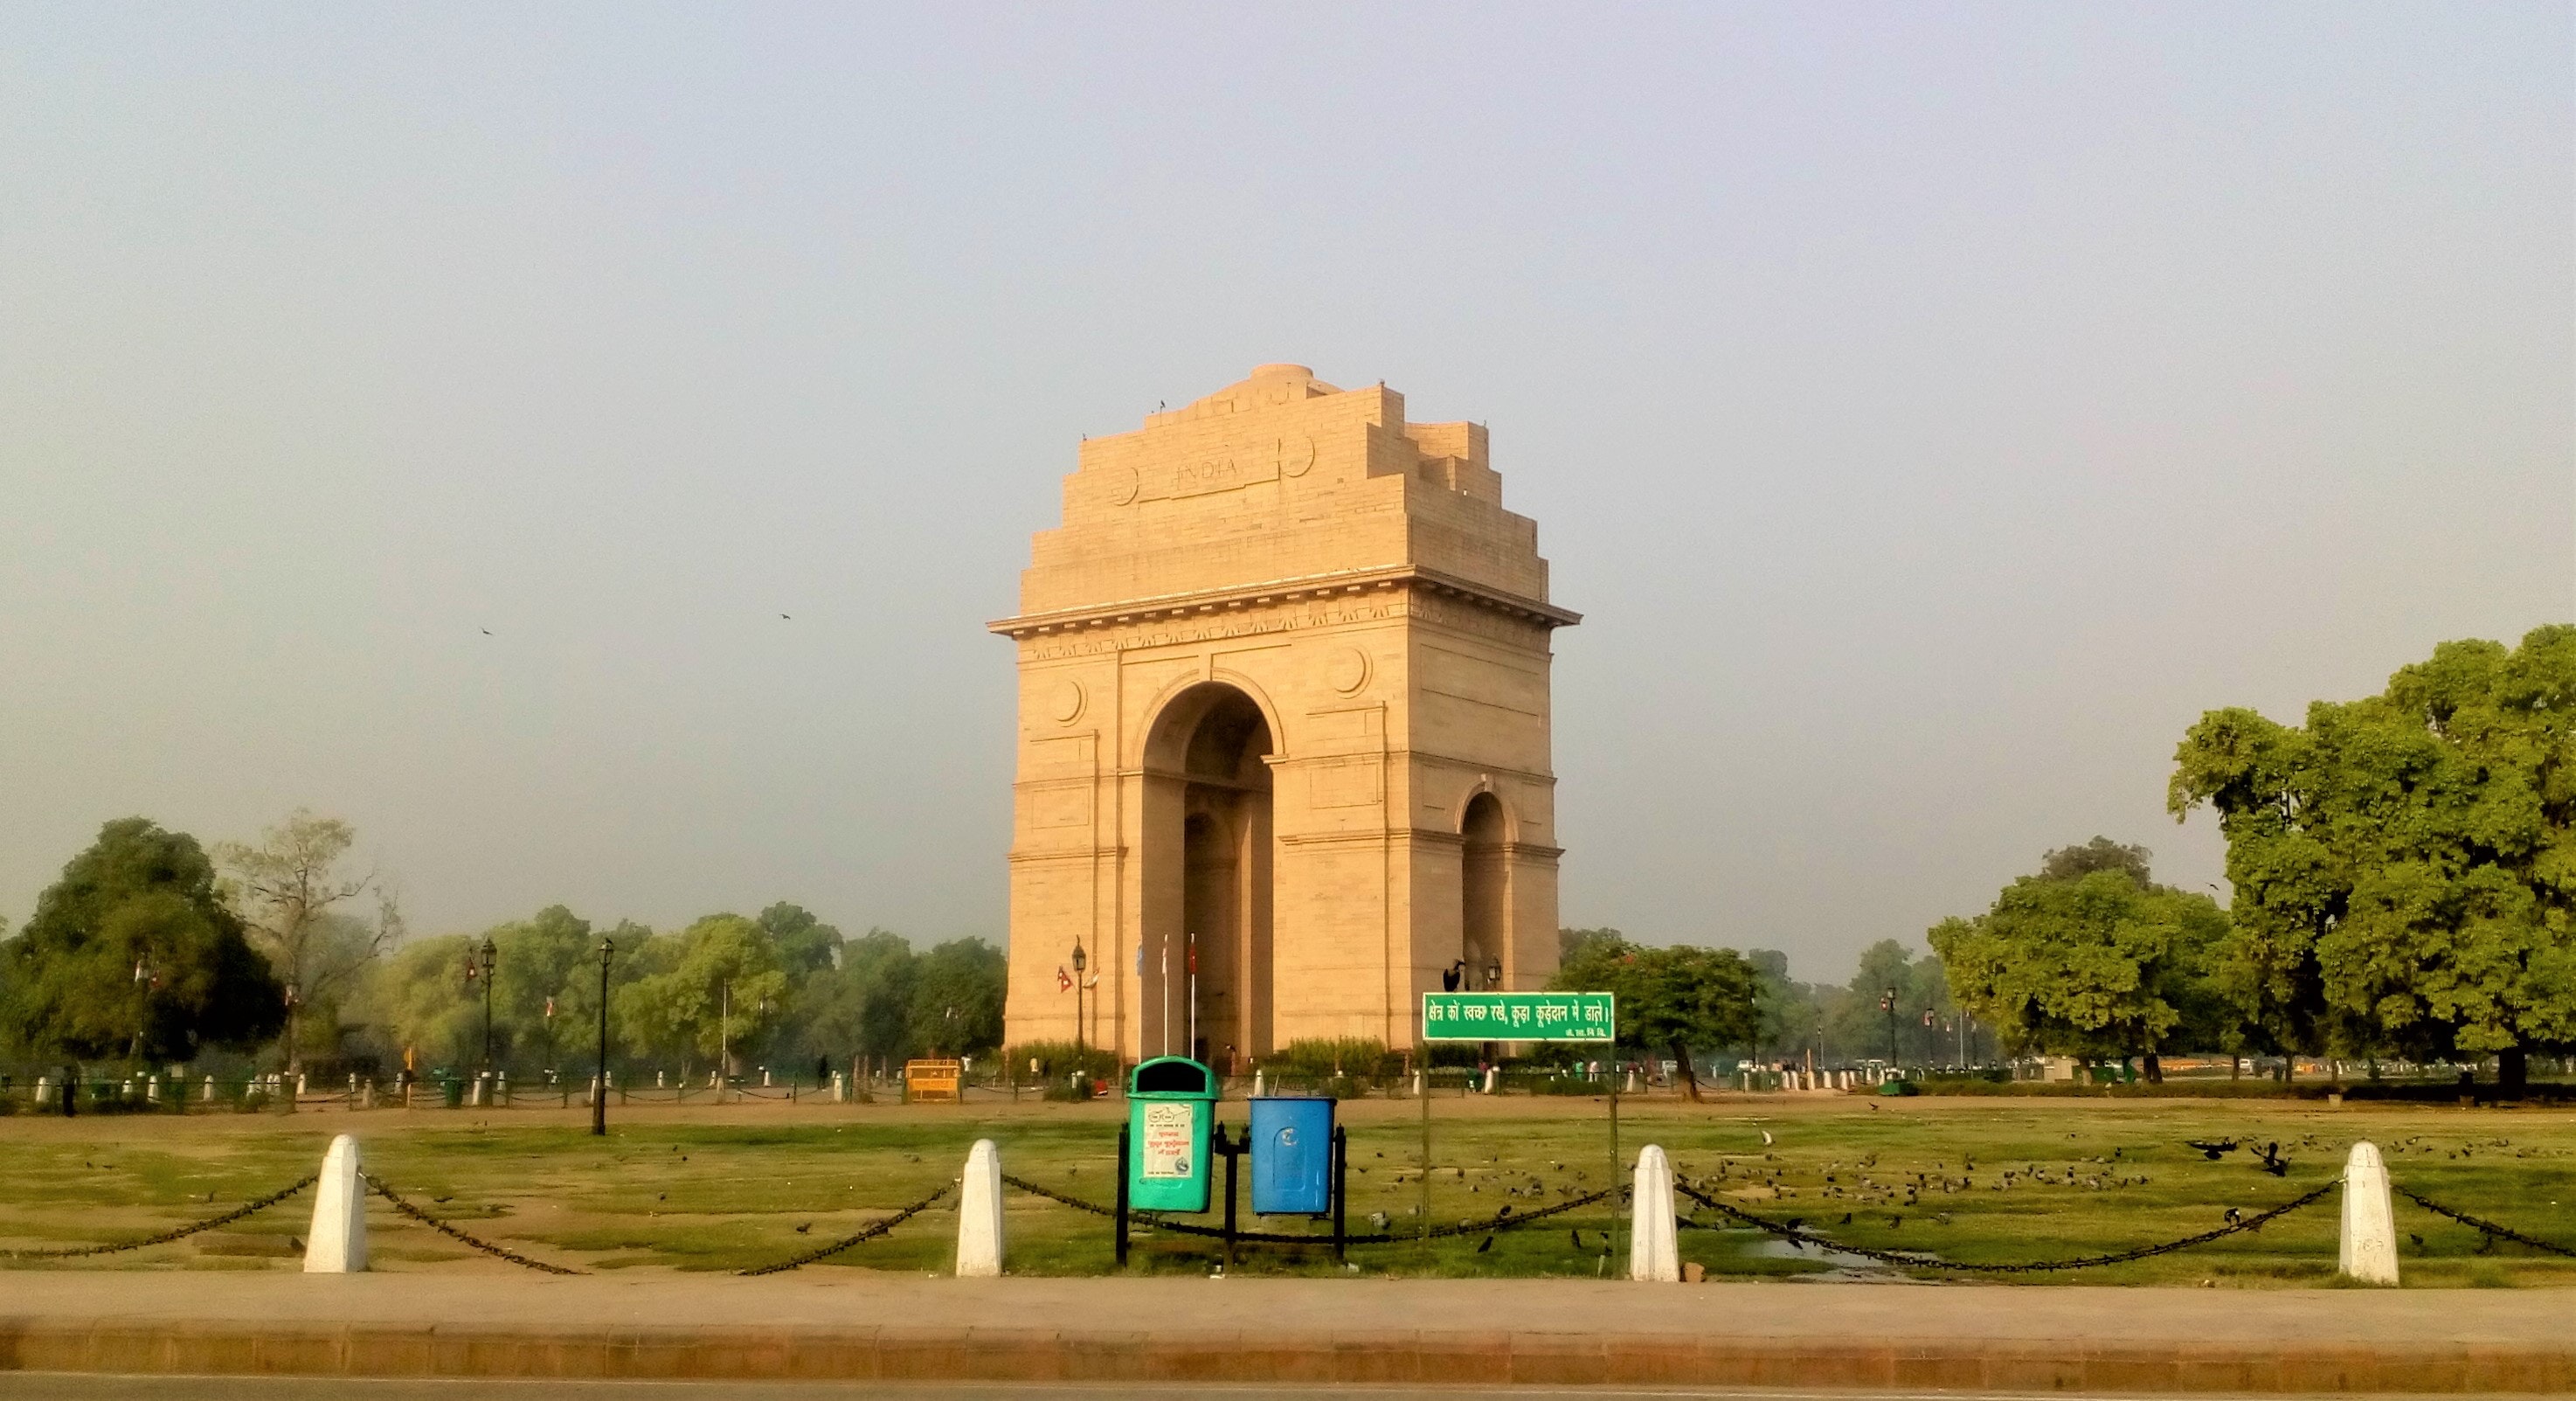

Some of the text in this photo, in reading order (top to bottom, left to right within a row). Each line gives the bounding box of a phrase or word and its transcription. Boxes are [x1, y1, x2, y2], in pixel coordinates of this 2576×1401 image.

[1174, 457, 1237, 489] INDIA
[1429, 999, 1444, 1022] क्षेत्र
[1463, 1004, 1487, 1022] स्वच्छ
